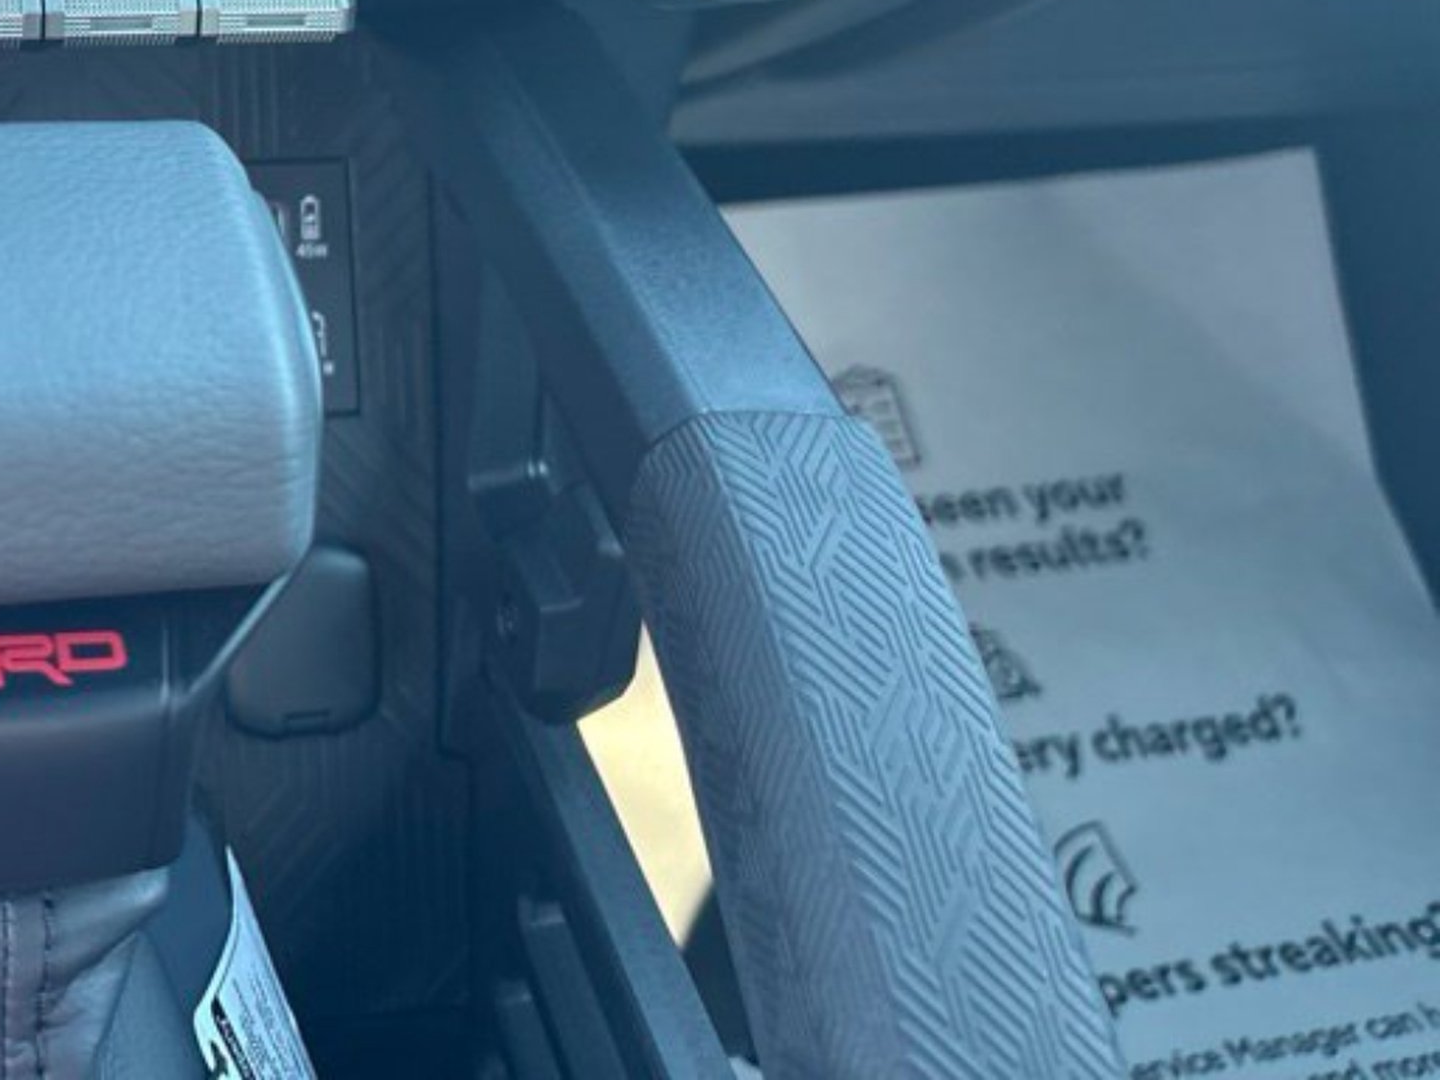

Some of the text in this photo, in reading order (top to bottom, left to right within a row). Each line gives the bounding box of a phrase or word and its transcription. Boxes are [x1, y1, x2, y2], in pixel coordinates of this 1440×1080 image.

[1021, 472, 1124, 527] your
[966, 517, 1152, 580] results?
[1014, 692, 1302, 780] ery charged?
[1098, 958, 1206, 1019] pers
[1223, 1022, 1359, 1065] Manager
[1364, 1012, 1424, 1040] can
